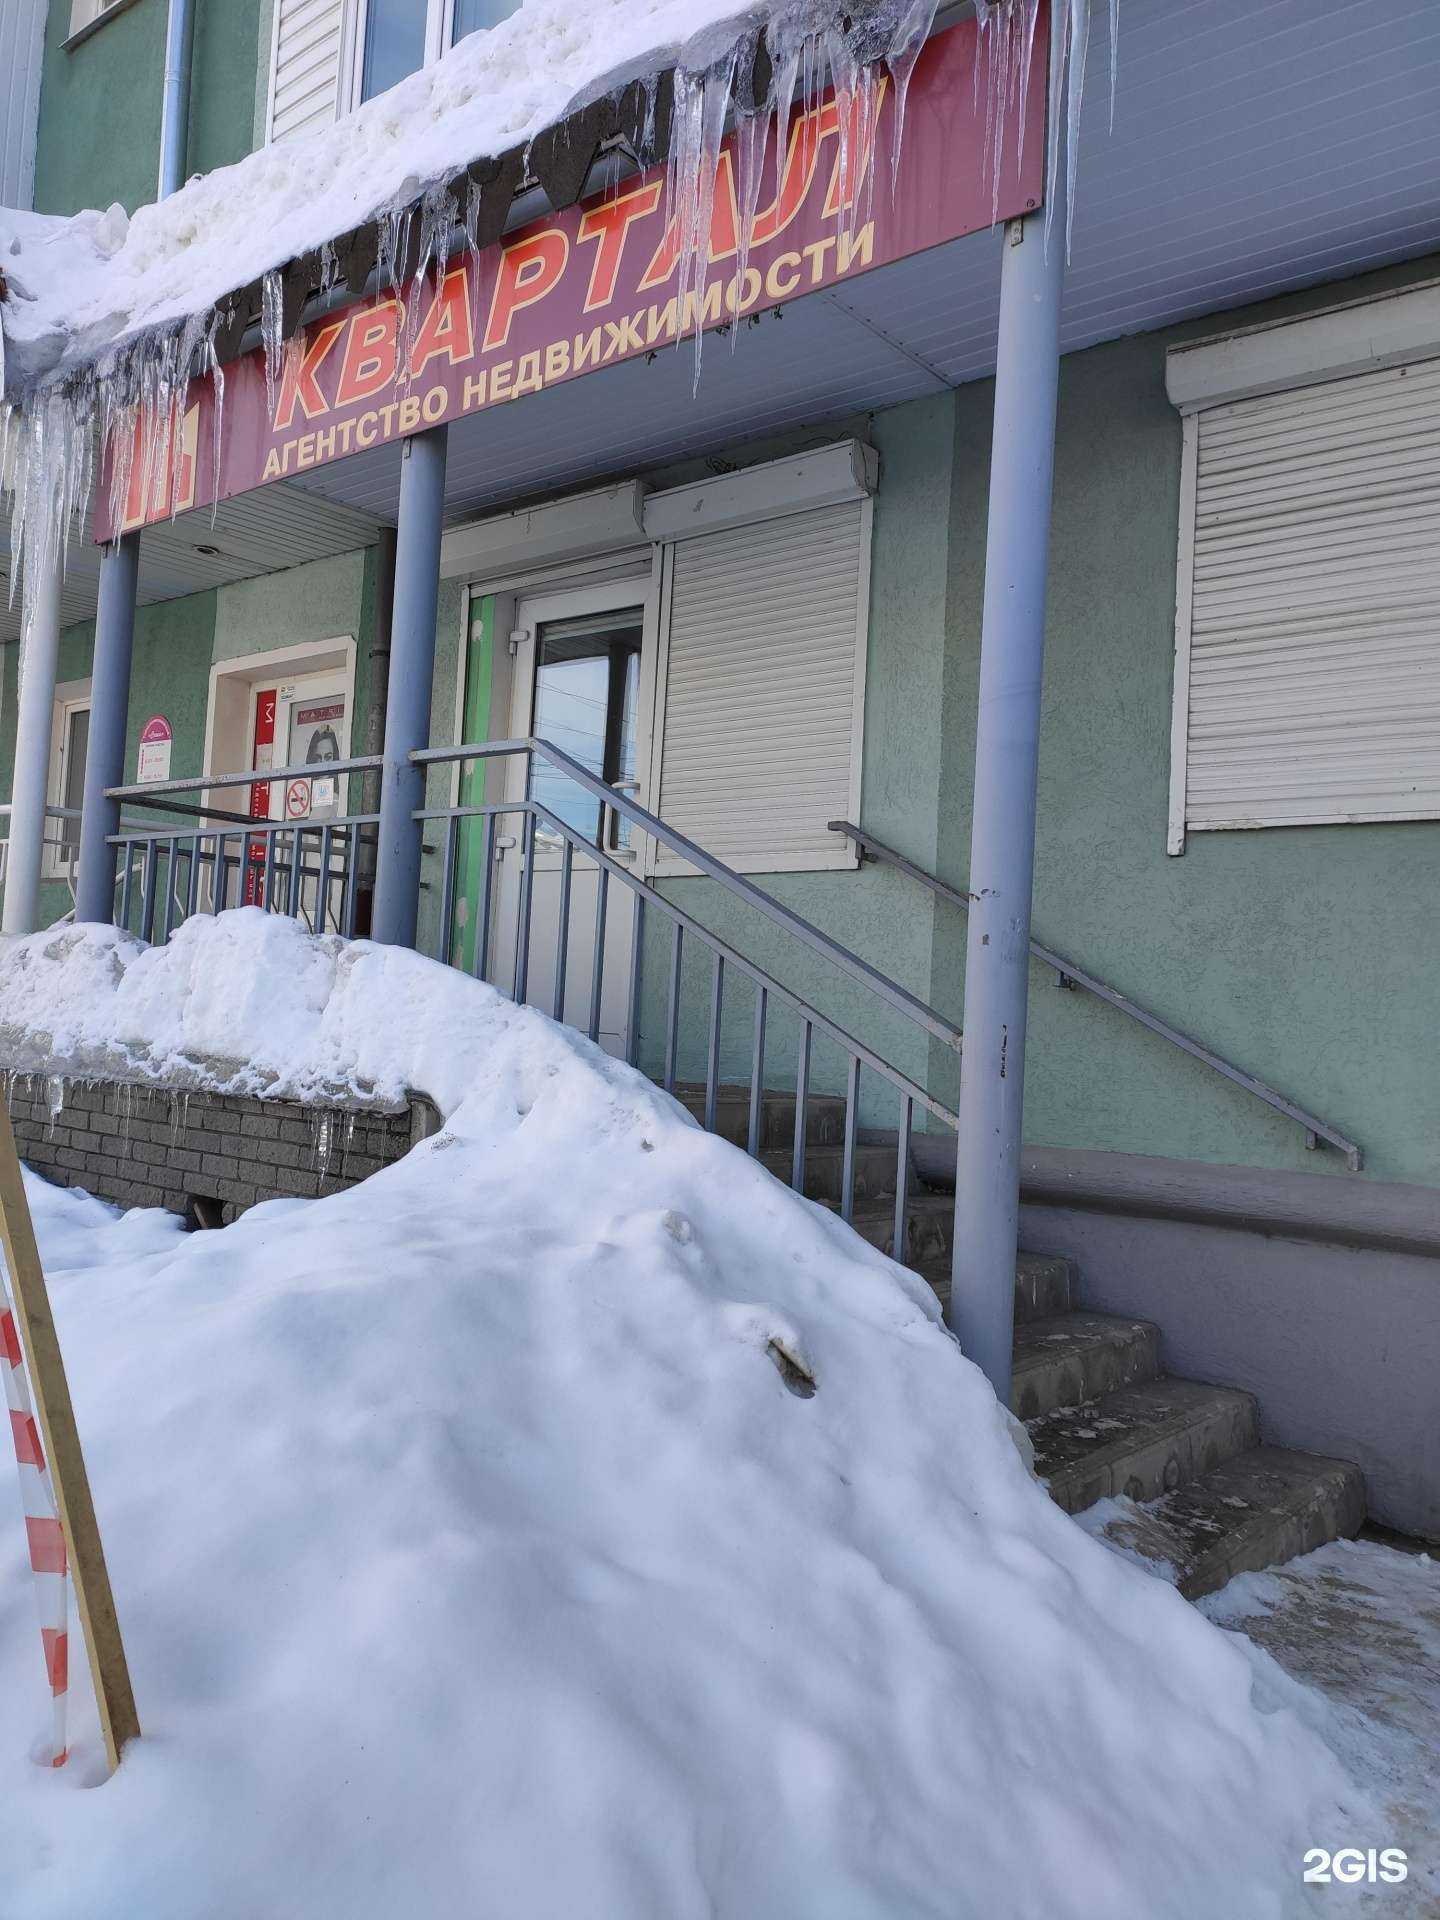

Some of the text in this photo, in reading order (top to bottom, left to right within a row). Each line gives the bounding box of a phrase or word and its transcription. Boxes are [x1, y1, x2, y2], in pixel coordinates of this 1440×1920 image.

[262, 221, 875, 481] АГЕНТСТВО НЕДВИЖИМОСТИ
[273, 75, 888, 432] КВАРТАЛ
